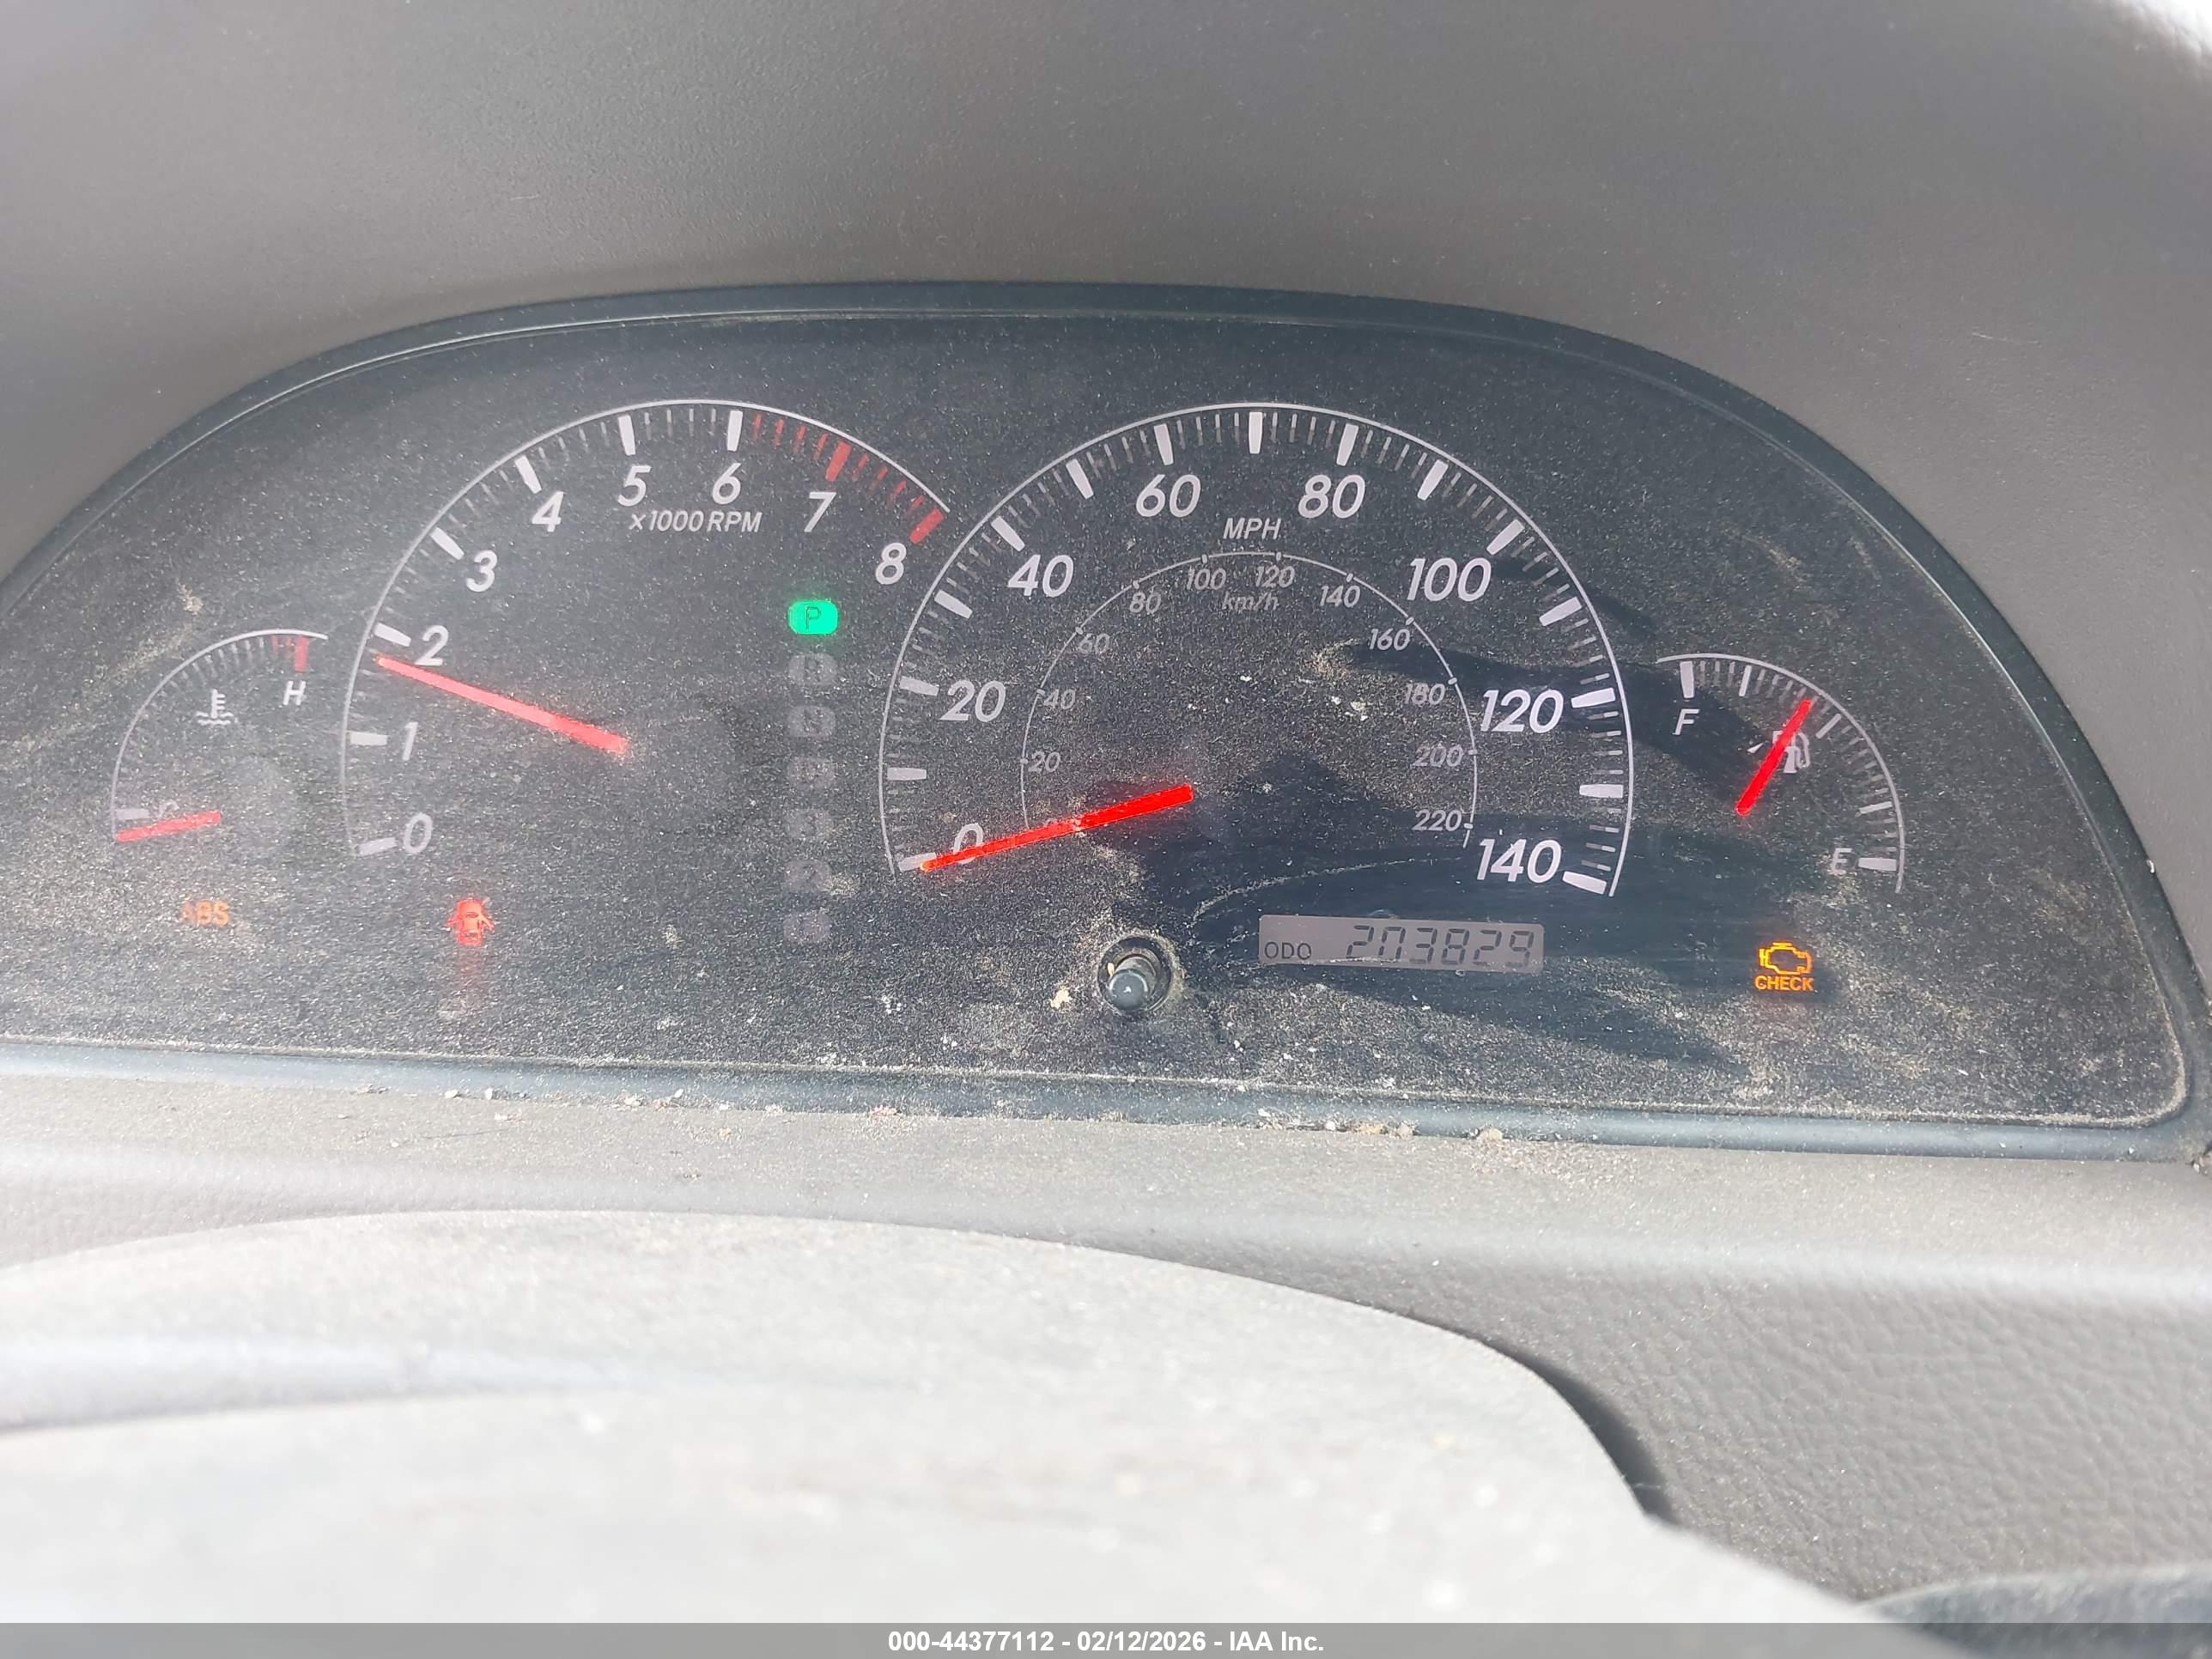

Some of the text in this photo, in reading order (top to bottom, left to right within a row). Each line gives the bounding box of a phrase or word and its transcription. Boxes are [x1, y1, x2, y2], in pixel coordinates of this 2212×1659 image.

[617, 465, 651, 507] 5
[712, 463, 742, 505] 6
[1135, 474, 1201, 517] 60
[1297, 474, 1365, 519] 80
[532, 491, 563, 532] 4
[707, 511, 763, 532] RPM
[803, 491, 836, 533] 7
[1223, 518, 1281, 539] MPH
[465, 550, 498, 592] 3
[875, 543, 907, 585] 8
[1007, 555, 1074, 598] 40
[1255, 566, 1295, 588] 120
[1187, 568, 1225, 591] 100
[1407, 557, 1492, 602] 100
[1129, 592, 1162, 613] 80
[1222, 592, 1279, 611] km/h
[1320, 585, 1361, 607] 140
[415, 625, 449, 666] 2
[1079, 633, 1111, 654] 60
[1369, 629, 1411, 651] 160
[283, 681, 306, 706] H
[940, 680, 1006, 722] 20
[1042, 689, 1076, 710] 40
[1404, 684, 1446, 705] 180
[1480, 690, 1564, 733] 120
[1672, 708, 1700, 736] F
[401, 721, 419, 761] 1
[1030, 750, 1061, 773] 20
[1413, 744, 1465, 768] 200
[403, 813, 432, 854] 0
[1413, 810, 1462, 832] 220
[1477, 838, 1563, 884] 140
[1831, 848, 1853, 876] E
[179, 900, 231, 927] ABS
[1264, 924, 1535, 969] ODO 203829
[1754, 975, 1814, 992] CHECK
